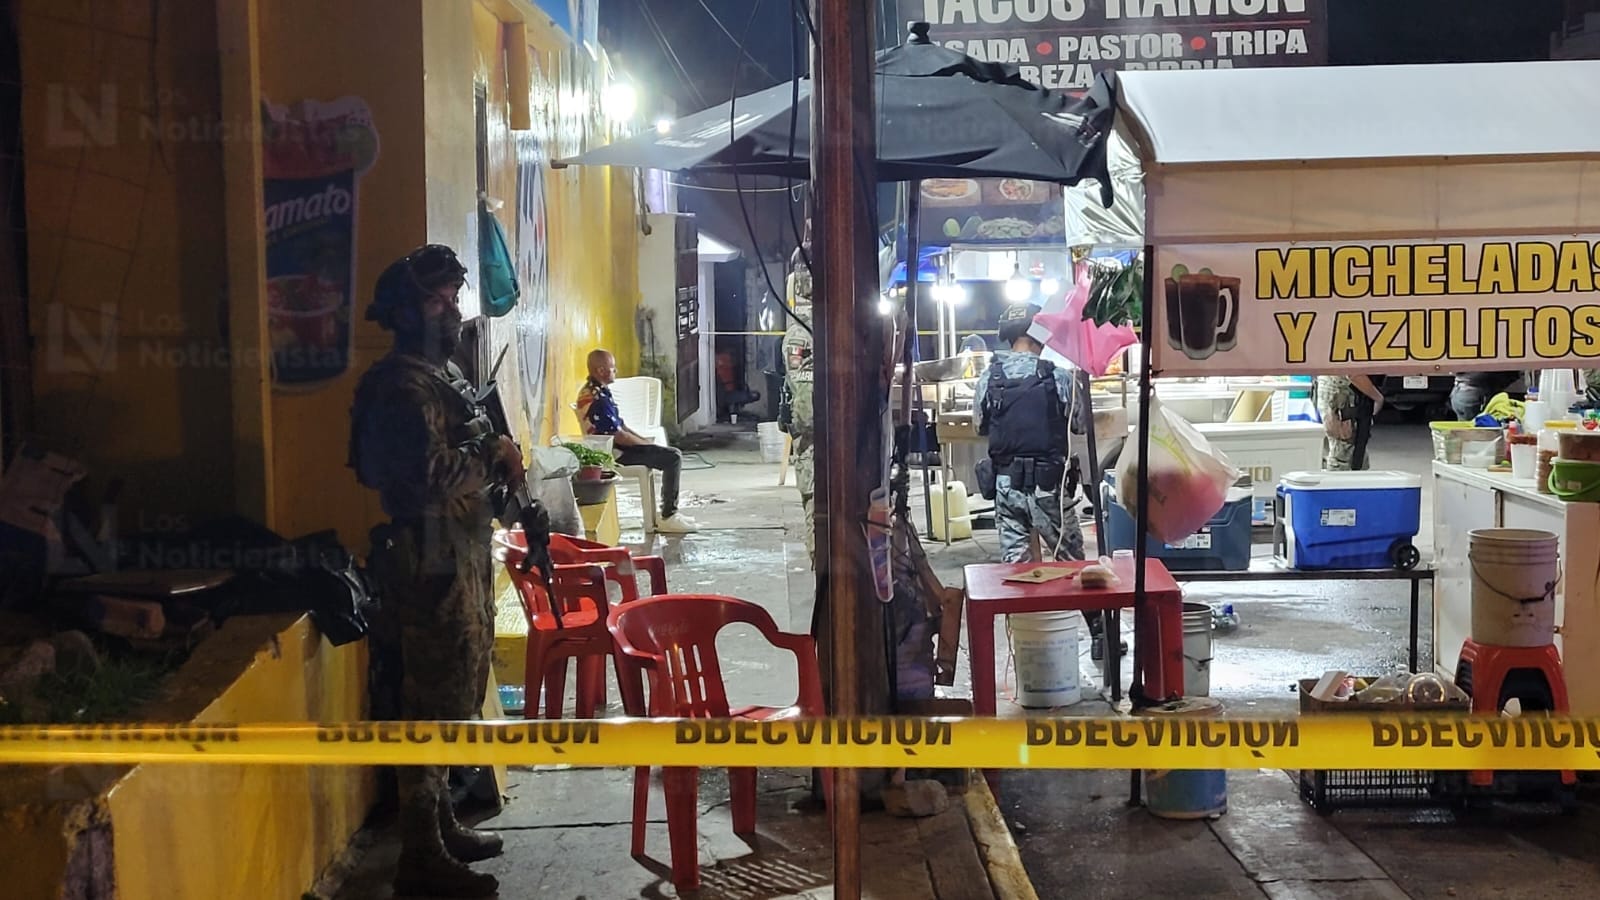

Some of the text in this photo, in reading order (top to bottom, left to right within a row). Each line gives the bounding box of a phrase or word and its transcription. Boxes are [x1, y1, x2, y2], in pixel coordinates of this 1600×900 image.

[933, 28, 1308, 63] ADA PASTOR TRIPA
[1255, 240, 1600, 299] MICHELADA
[1274, 304, 1600, 363] Y AZULITOS
